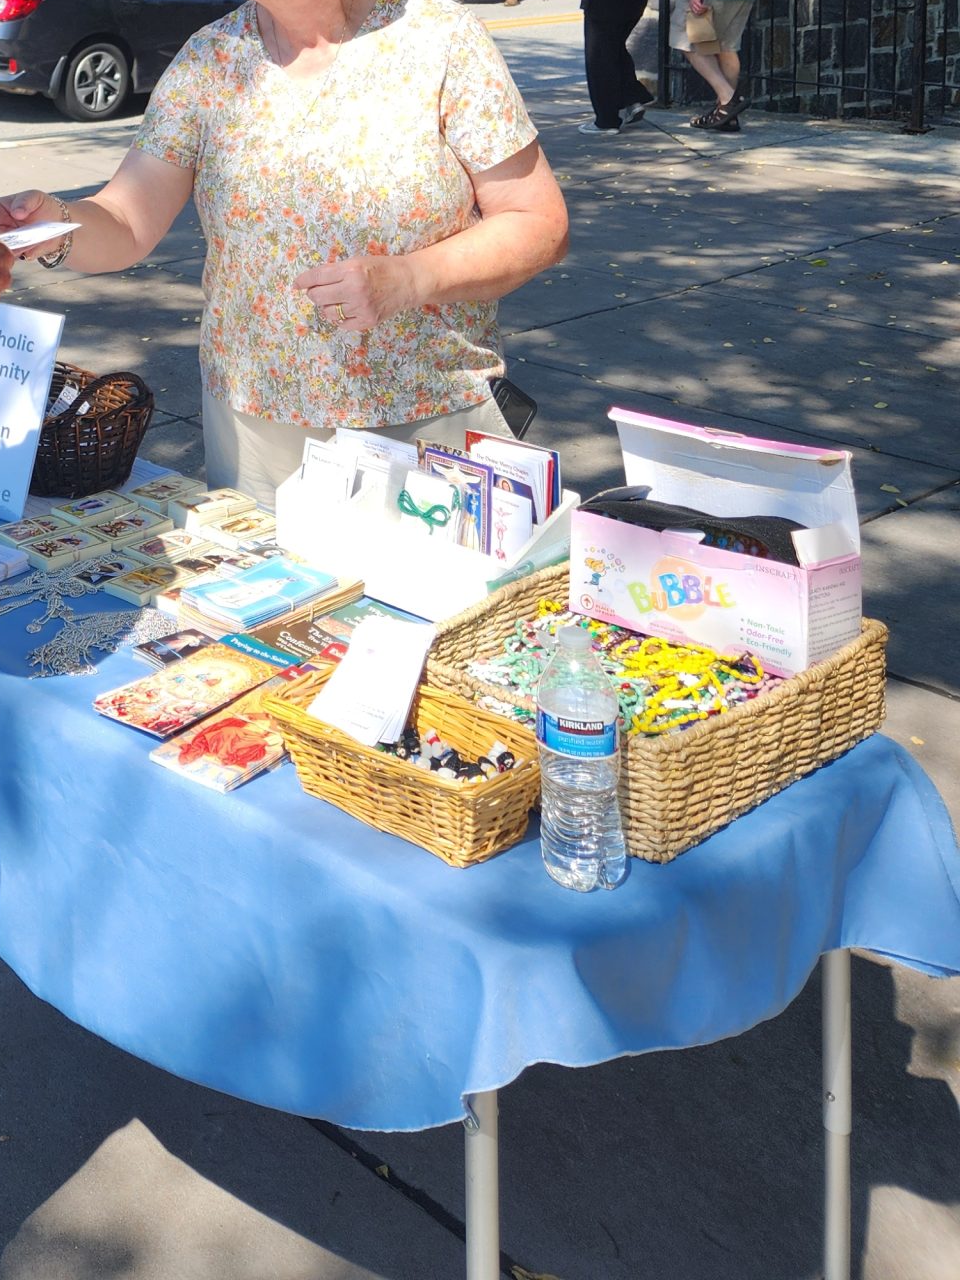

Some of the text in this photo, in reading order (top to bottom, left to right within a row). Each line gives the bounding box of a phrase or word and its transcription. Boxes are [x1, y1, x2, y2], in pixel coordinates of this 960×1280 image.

[308, 626, 323, 639] The
[746, 618, 785, 635] Non-Toxic
[746, 628, 784, 645] Odor-Free
[260, 649, 272, 661] the
[746, 638, 792, 657] Eco-Friendly
[559, 719, 603, 731] KIRKLAND
